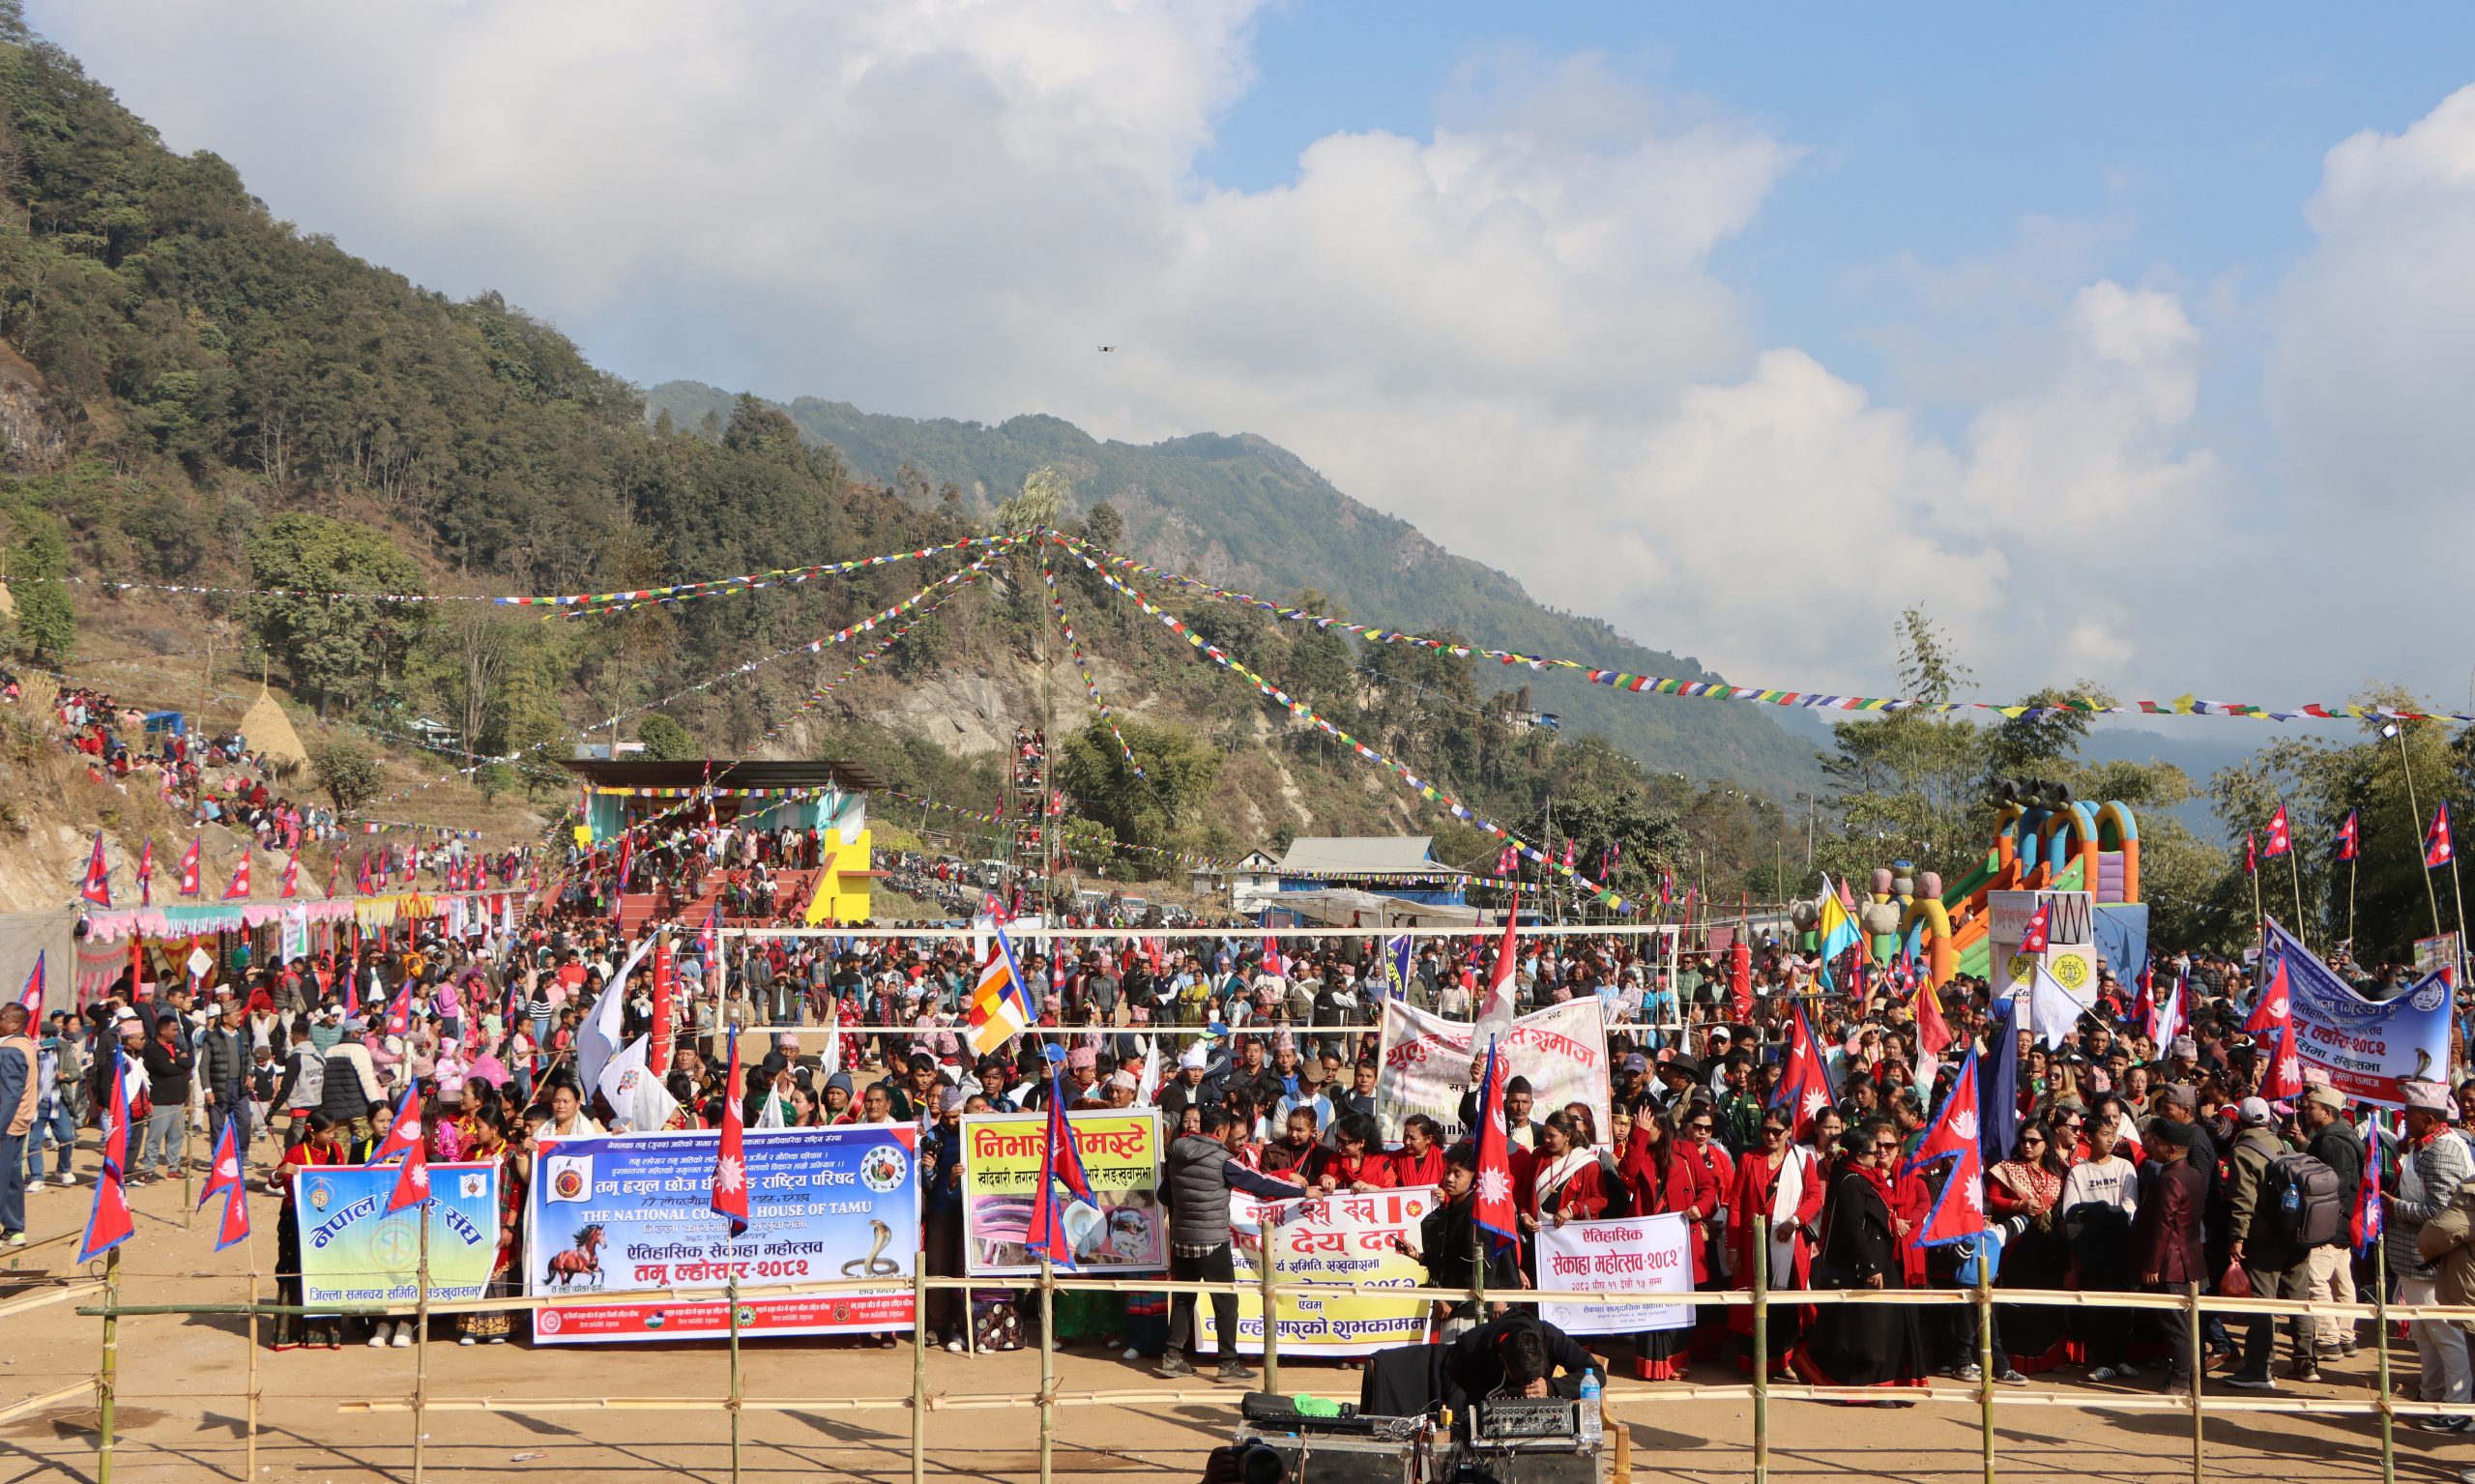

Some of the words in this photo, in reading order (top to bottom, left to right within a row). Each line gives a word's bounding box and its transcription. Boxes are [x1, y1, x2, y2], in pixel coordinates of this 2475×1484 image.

[1071, 1123, 1148, 1159] ोमस्टे
[812, 1169, 856, 1187] परिषद
[309, 1195, 376, 1249] नेपाल
[445, 1207, 483, 1246] संघ
[581, 1209, 610, 1223] THE
[613, 1208, 687, 1223] NATIONAL
[691, 1207, 753, 1221] COUL
[757, 1204, 806, 1218] HOUSE
[808, 1203, 827, 1216] OF
[829, 1201, 873, 1215] TAMU
[1583, 1227, 1644, 1243] ऐतिहासिक
[626, 1243, 703, 1261] ऐतिहासिक
[709, 1240, 758, 1259] सेकाहा
[764, 1239, 824, 1256] महोत्सव
[634, 1263, 670, 1286] तमू
[309, 1288, 341, 1300] जिल्ला
[345, 1289, 384, 1301] समन्वय
[387, 1286, 418, 1299] समिति
